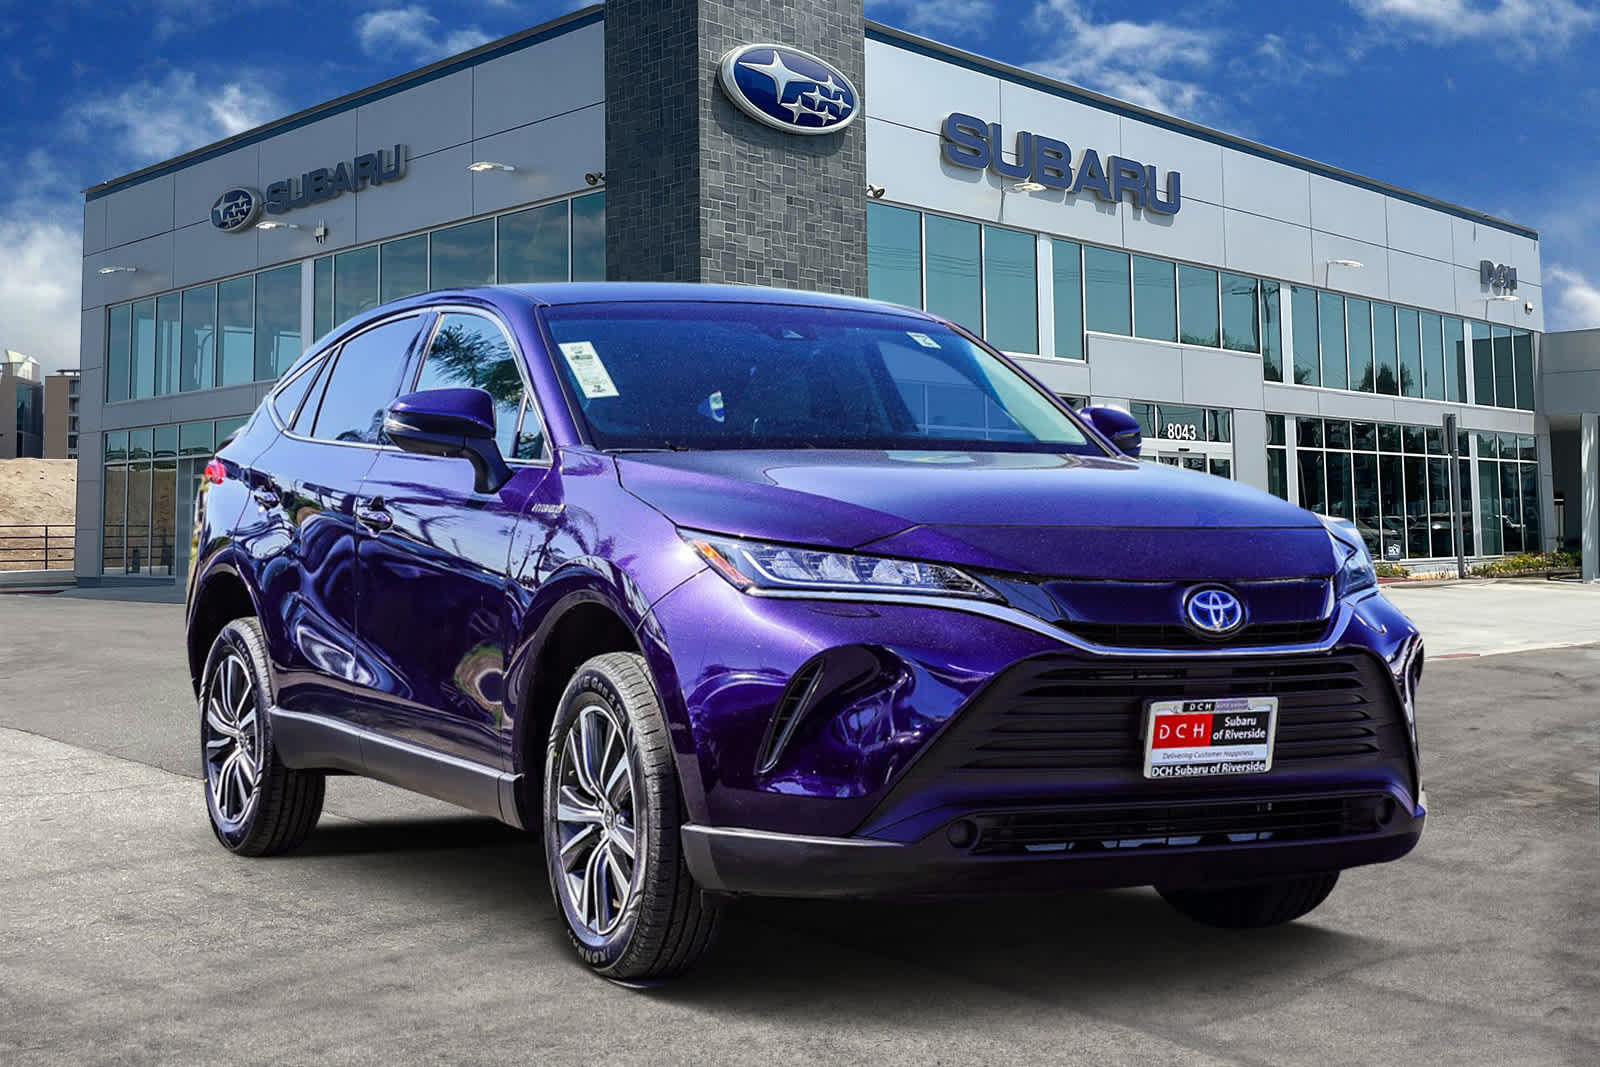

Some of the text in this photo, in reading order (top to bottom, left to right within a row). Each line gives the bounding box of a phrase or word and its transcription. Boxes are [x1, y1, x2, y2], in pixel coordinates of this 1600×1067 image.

[940, 112, 1181, 215] SUBARU
[266, 144, 406, 214] SUBARU
[1167, 423, 1196, 440] 8043
[1189, 702, 1212, 711] DCH
[1224, 716, 1257, 727] Subaru
[1159, 723, 1205, 740] DCH
[1212, 727, 1266, 741] of Riverside
[1162, 752, 1193, 760] Delivering
[1194, 750, 1222, 758] Customer
[1151, 761, 1266, 777] DCH Subaru of Riverside
